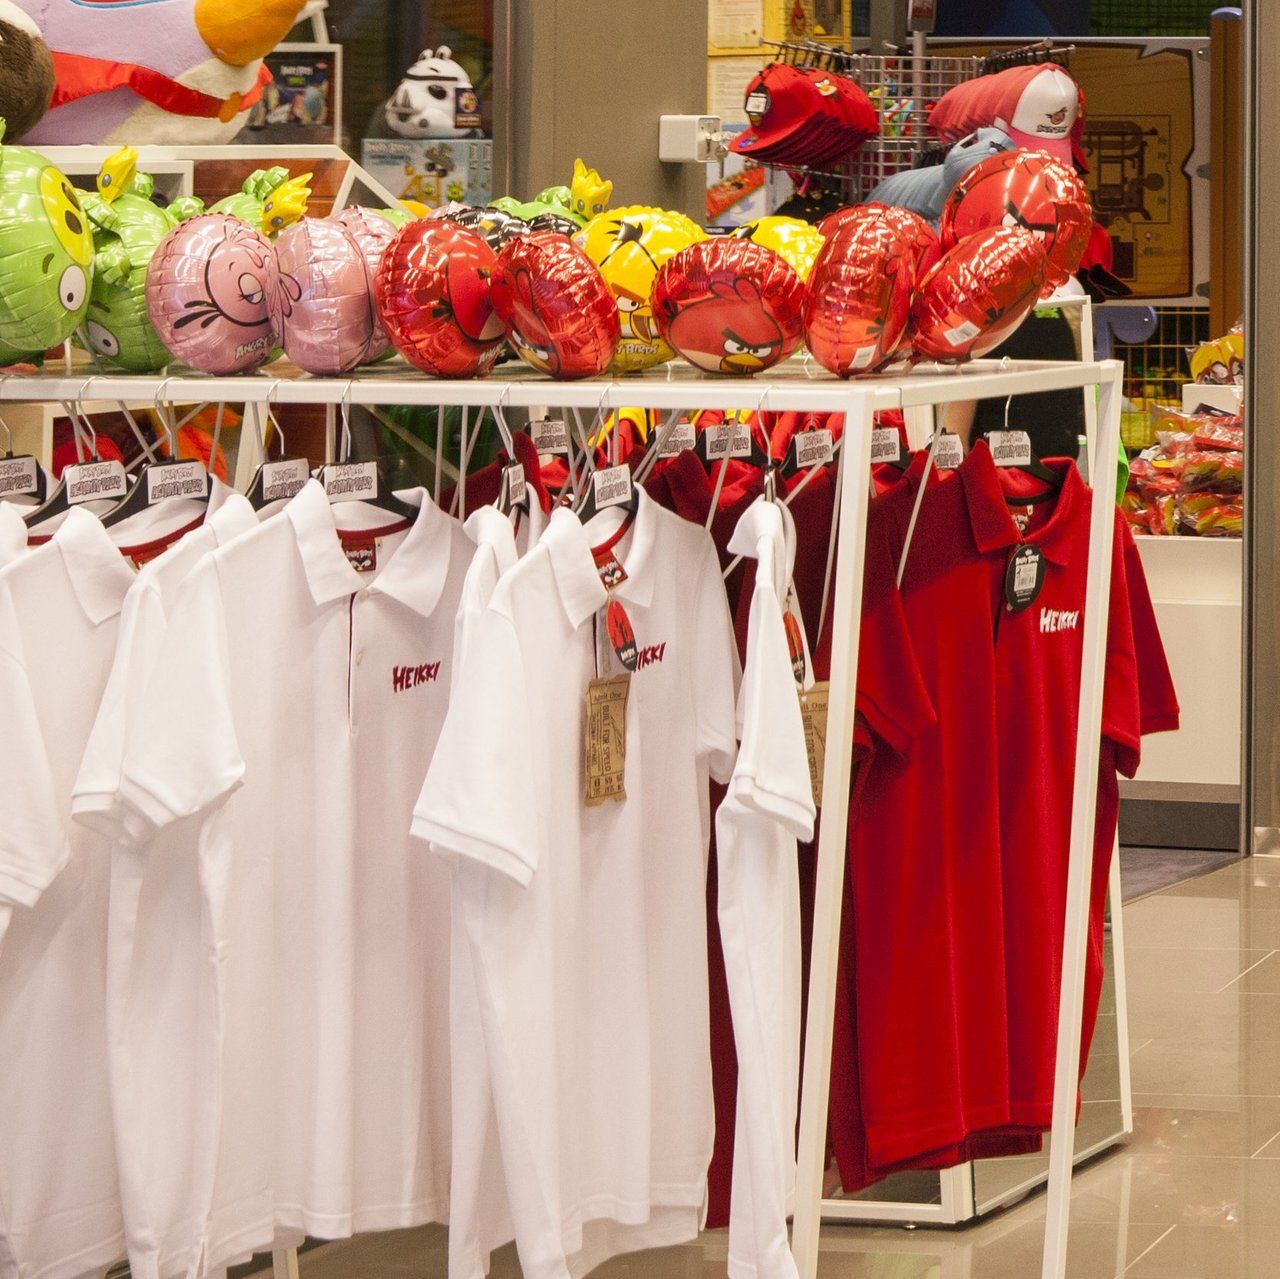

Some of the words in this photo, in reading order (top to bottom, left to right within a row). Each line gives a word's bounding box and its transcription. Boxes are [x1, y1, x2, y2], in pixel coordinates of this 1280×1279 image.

[1040, 607, 1080, 634] HEIKKI
[634, 641, 667, 673] IKKI
[392, 660, 441, 694] HEIKKI
[812, 702, 827, 710] One
